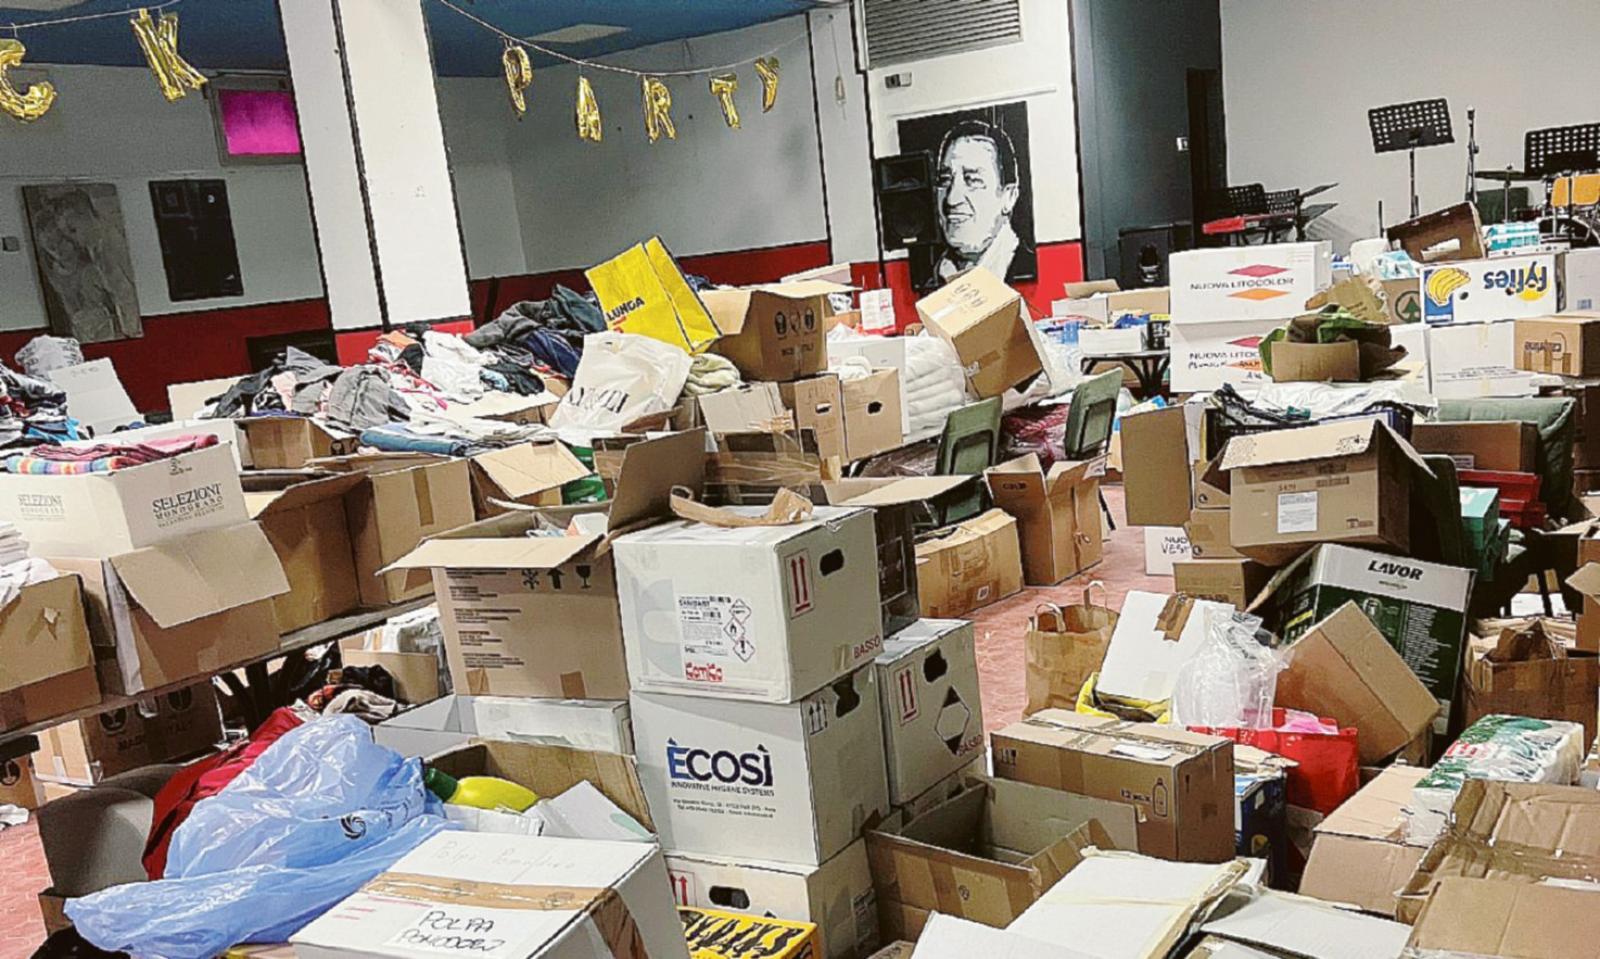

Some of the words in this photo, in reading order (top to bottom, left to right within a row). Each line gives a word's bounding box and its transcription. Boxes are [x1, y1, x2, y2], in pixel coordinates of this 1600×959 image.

[503, 46, 780, 143] PARTY
[1190, 282, 1229, 290] NUOVA
[1231, 278, 1294, 289] LITOCOLOR
[606, 297, 645, 321] LUNGA
[1189, 352, 1228, 360] NUOVA
[152, 483, 222, 513] SELEZIONI
[1367, 560, 1423, 580] LAVOR
[854, 635, 880, 659] BASSO
[671, 781, 710, 792] INNOVATIVE
[711, 784, 740, 794] HYGIENE
[742, 787, 775, 797] SYSTEMS
